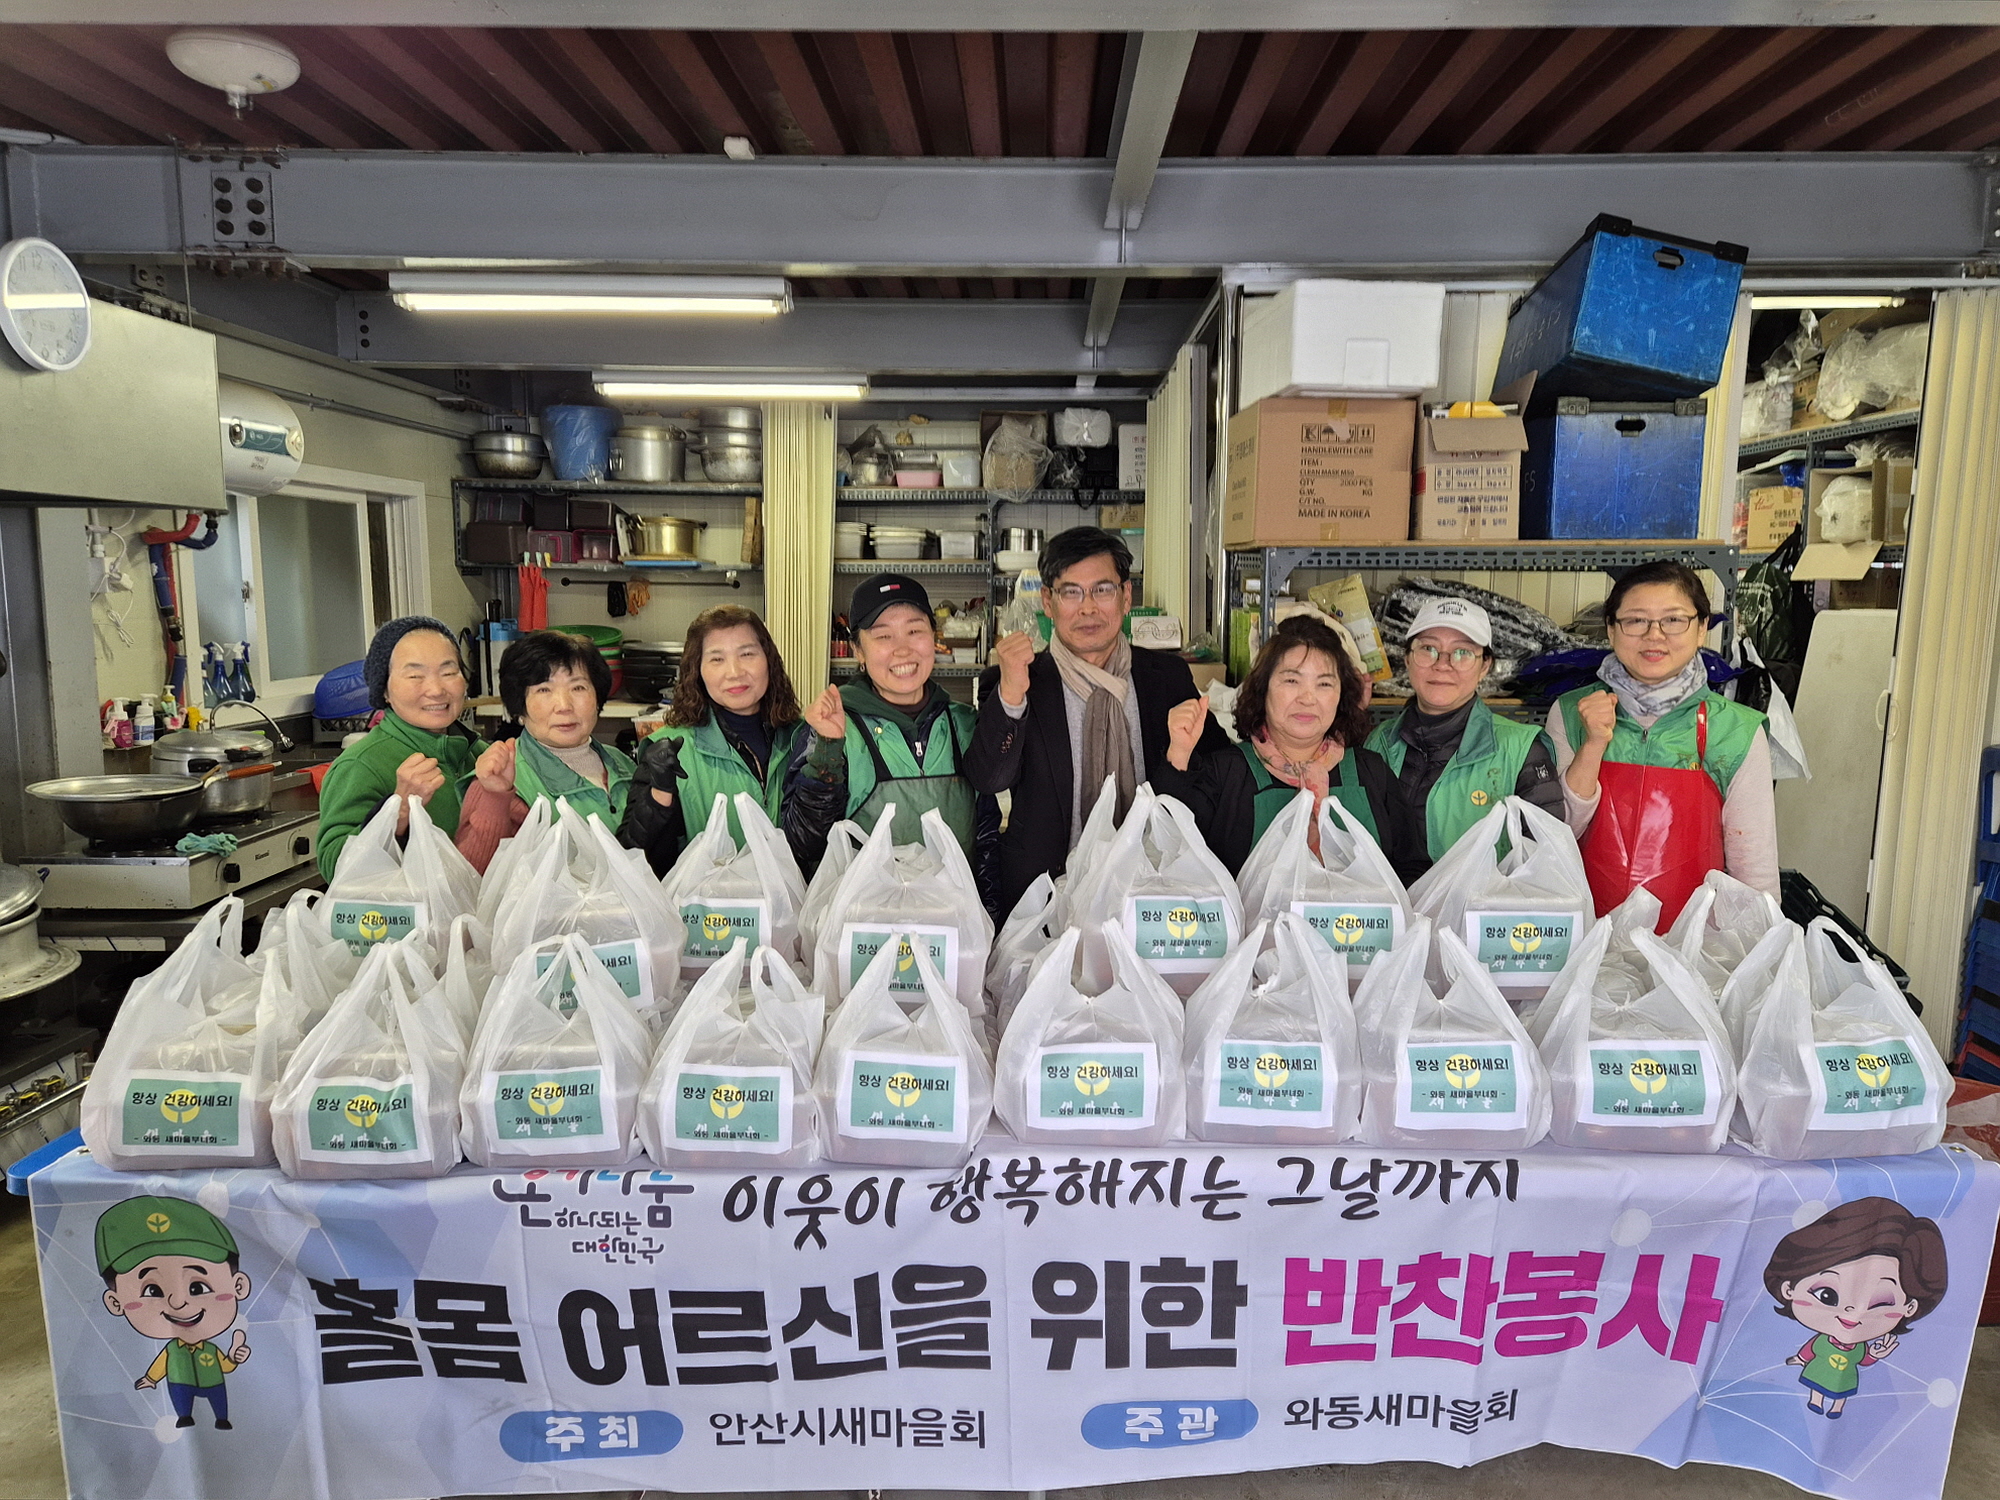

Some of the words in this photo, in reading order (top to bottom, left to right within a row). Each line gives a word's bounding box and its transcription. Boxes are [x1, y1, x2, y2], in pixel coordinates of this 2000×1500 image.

[1298, 509, 1325, 518] MADE
[1328, 509, 1338, 518] IN
[1340, 509, 1370, 518] KOREA
[336, 913, 356, 924] 항상
[362, 914, 411, 926] 건강하세요!
[704, 914, 755, 927] 건강하세요!
[1142, 911, 1162, 922] 항상
[1309, 917, 1329, 929] 항상
[1335, 918, 1389, 930] 건강하세요!
[1486, 927, 1506, 938] 항상
[1513, 927, 1567, 938] 건강하세요!
[857, 944, 878, 956] 항상
[1227, 1056, 1250, 1069] 항상
[1257, 1058, 1317, 1071] 건강하세요!
[1416, 1059, 1439, 1072] 항상
[1446, 1059, 1508, 1071] 건강하세요!
[1826, 1059, 1850, 1072] 항상
[1856, 1052, 1913, 1070] 건강하세요!
[1047, 1066, 1070, 1078] 항상
[1077, 1065, 1138, 1079] 건강하세요!
[1599, 1063, 1623, 1075] 항상
[1631, 1063, 1697, 1077] 건강하세요!
[859, 1074, 882, 1087] 항상
[888, 1076, 949, 1092] 건강하세요!
[501, 1088, 524, 1100] 항상
[531, 1084, 594, 1100] 건강하세요!
[683, 1087, 706, 1100] 항상
[713, 1088, 774, 1103] 건강하세요!
[1238, 1086, 1253, 1095] 와동
[1258, 1088, 1305, 1098] 새마을부녀회
[1451, 1090, 1498, 1099] 새마을부녀회
[1845, 1091, 1860, 1100] 와동
[1864, 1086, 1909, 1099] 새마을부녀회
[132, 1092, 157, 1106] 항상
[165, 1093, 233, 1108] 건강하세요!
[317, 1098, 341, 1111] 항상
[1079, 1107, 1125, 1116] 새마을부녀회
[1613, 1105, 1629, 1113] 와동
[1634, 1106, 1685, 1114] 새마을부녀회
[515, 1116, 531, 1125] 와동
[535, 1115, 583, 1126] 새마을부녀회
[869, 1118, 884, 1126] 와동
[888, 1119, 935, 1129] 새마을부녀회
[143, 1136, 160, 1144] 와동
[165, 1136, 218, 1144] 새마을부녀회
[694, 1130, 709, 1138] 와동
[714, 1131, 760, 1140] 새마을부녀회
[330, 1141, 346, 1149] 와동
[723, 1174, 906, 1251] 이웃이
[930, 1155, 1248, 1226] 행복해지는
[1267, 1156, 1521, 1220] 그날까지
[555, 1207, 642, 1236] 하나되는
[572, 1234, 665, 1264] 대한민국
[307, 1276, 528, 1385] 홀몸
[558, 1264, 993, 1387] 어르신을
[1030, 1257, 1248, 1371] 위한
[1283, 1250, 1724, 1367] 반찬봉사
[1283, 1389, 1520, 1435] 와동새마을회
[708, 1406, 987, 1450] 안산시새마을회
